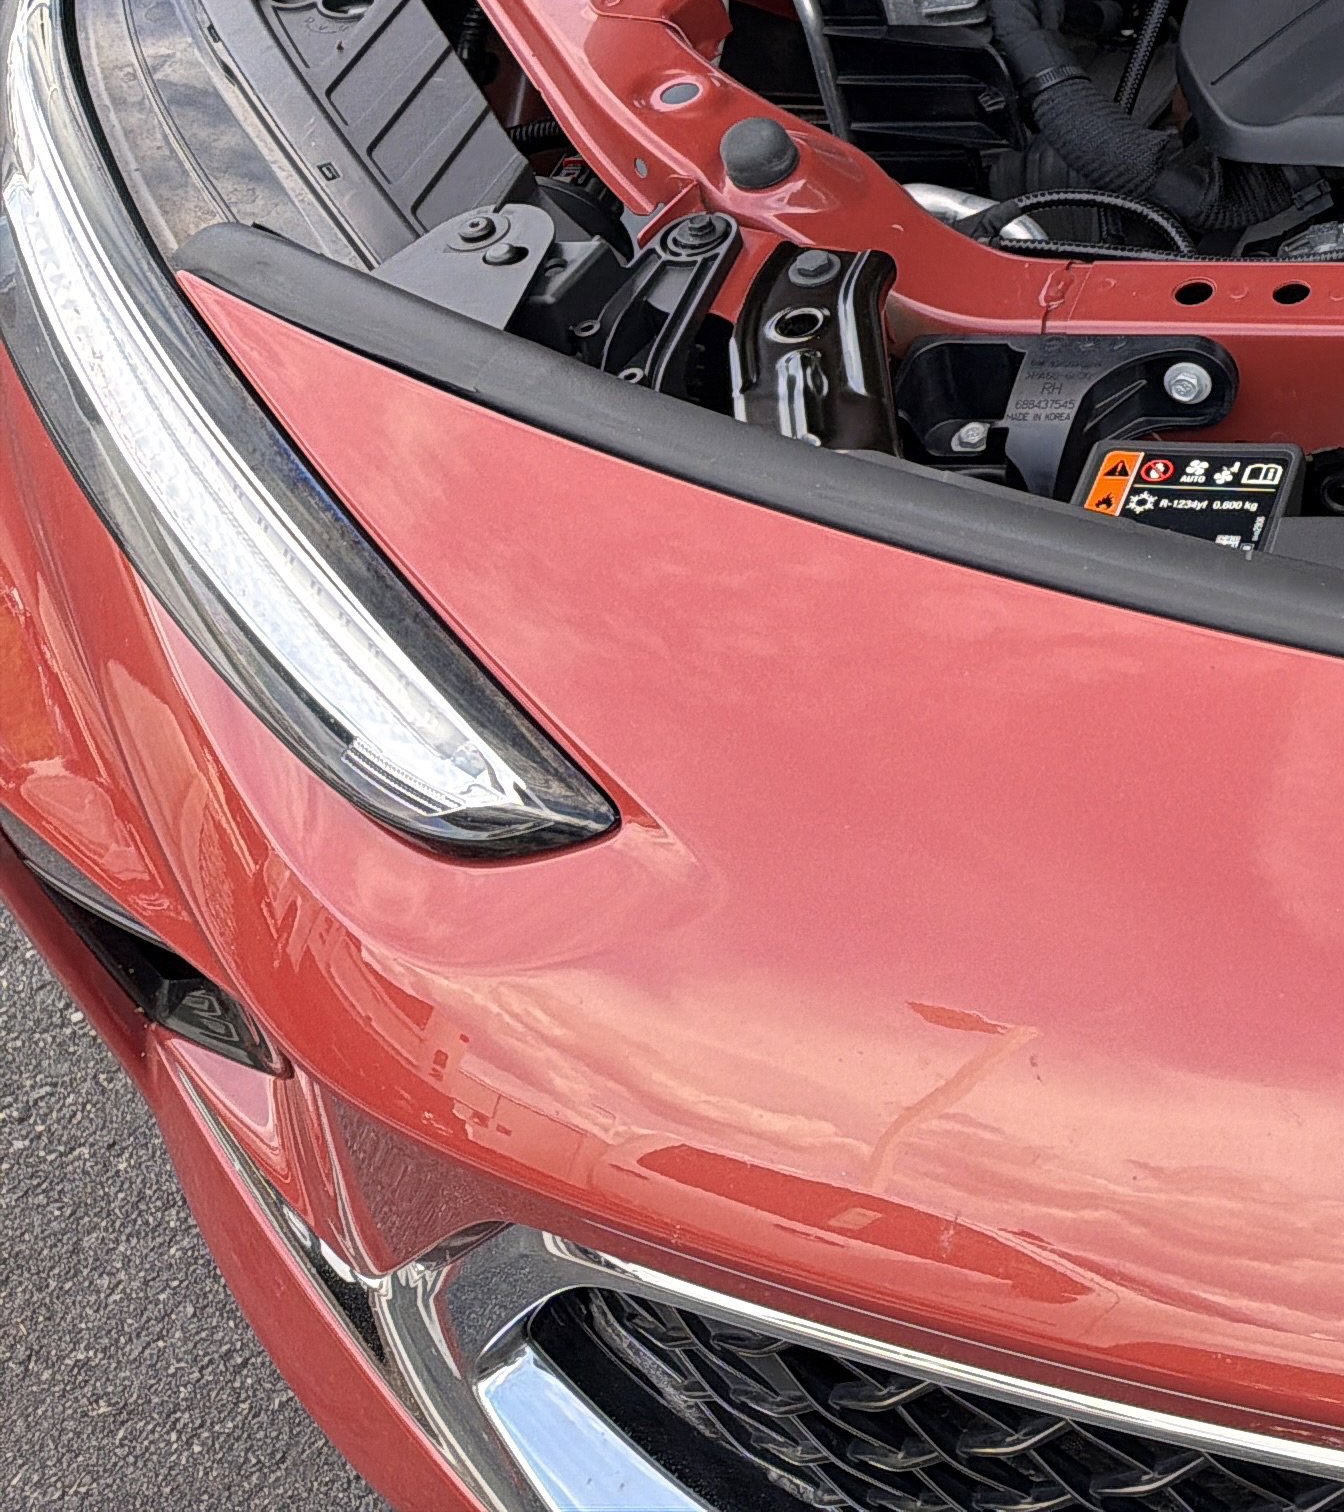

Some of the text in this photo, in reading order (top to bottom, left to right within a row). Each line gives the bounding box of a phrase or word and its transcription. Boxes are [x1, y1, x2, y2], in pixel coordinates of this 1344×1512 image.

[1041, 382, 1063, 395] RH
[1007, 412, 1071, 422] MADE IN KOREA
[1180, 475, 1206, 483] AUTO
[1159, 499, 1258, 511] R-1234yf 0.600 kg
